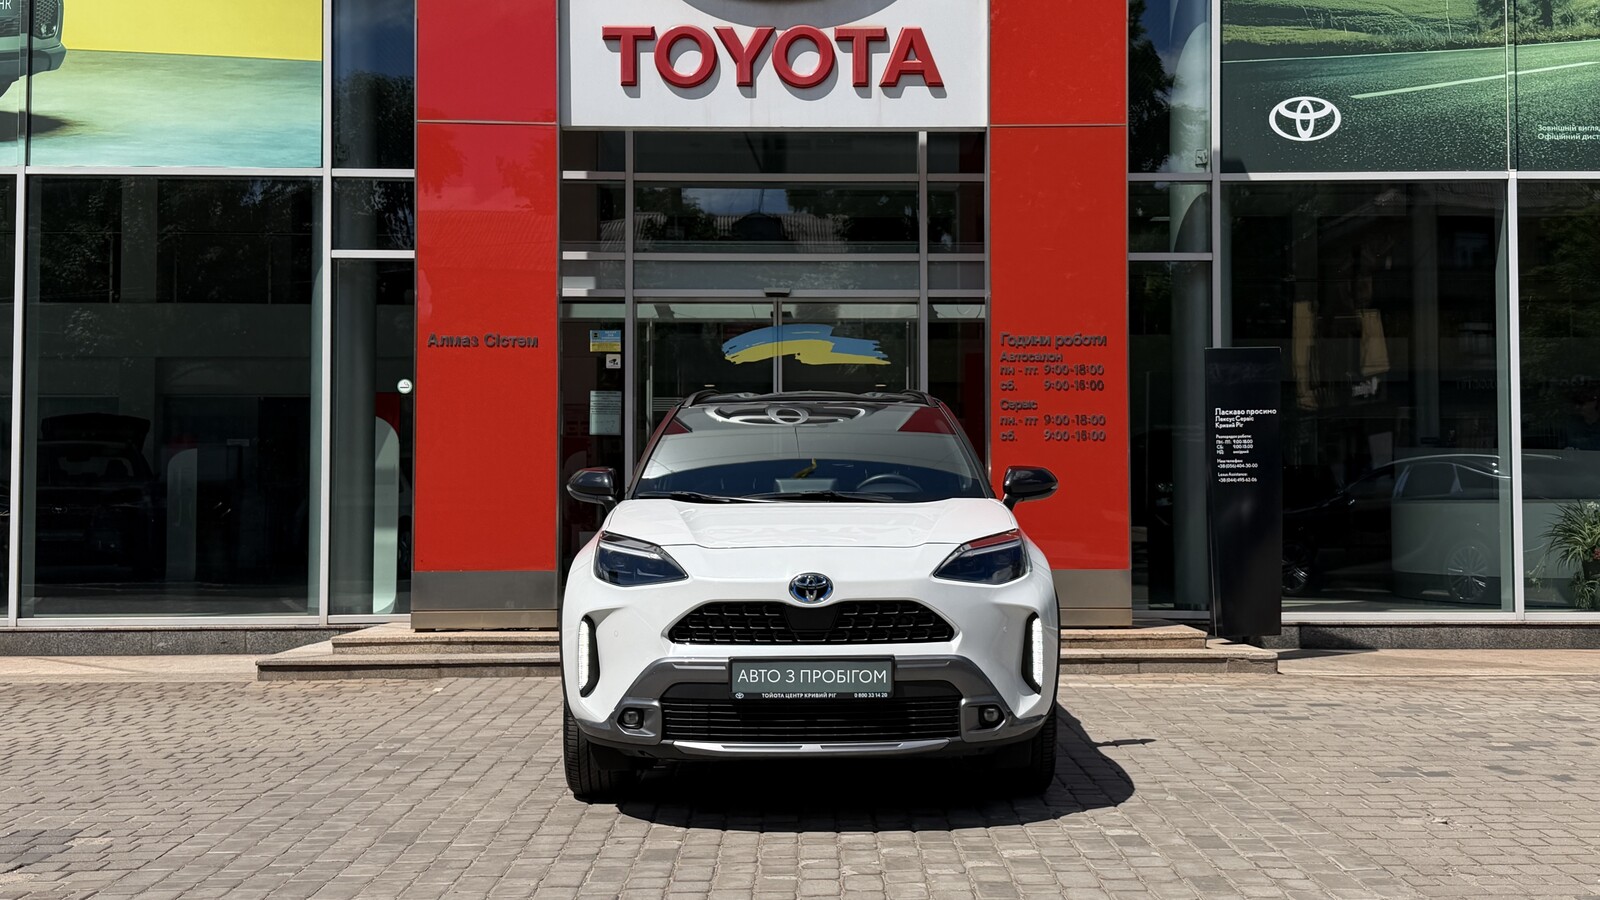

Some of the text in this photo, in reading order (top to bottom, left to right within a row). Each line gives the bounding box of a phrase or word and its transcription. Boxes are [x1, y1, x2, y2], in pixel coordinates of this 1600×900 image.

[602, 24, 944, 88] TOYOTA
[1538, 133, 1581, 141] Офіційний
[428, 333, 539, 348] Алмаз Сістем
[1000, 332, 1107, 350] Години роботи
[1000, 351, 1063, 362] Автосалон
[1000, 380, 1018, 391] сб.
[1000, 399, 1038, 413] Сервіс
[1000, 430, 1018, 441] сб.
[737, 669, 887, 683] АВТО З ПРОБІГОМ
[762, 691, 785, 699] ТОЙОТА
[804, 691, 828, 699] КРИВИЙ
